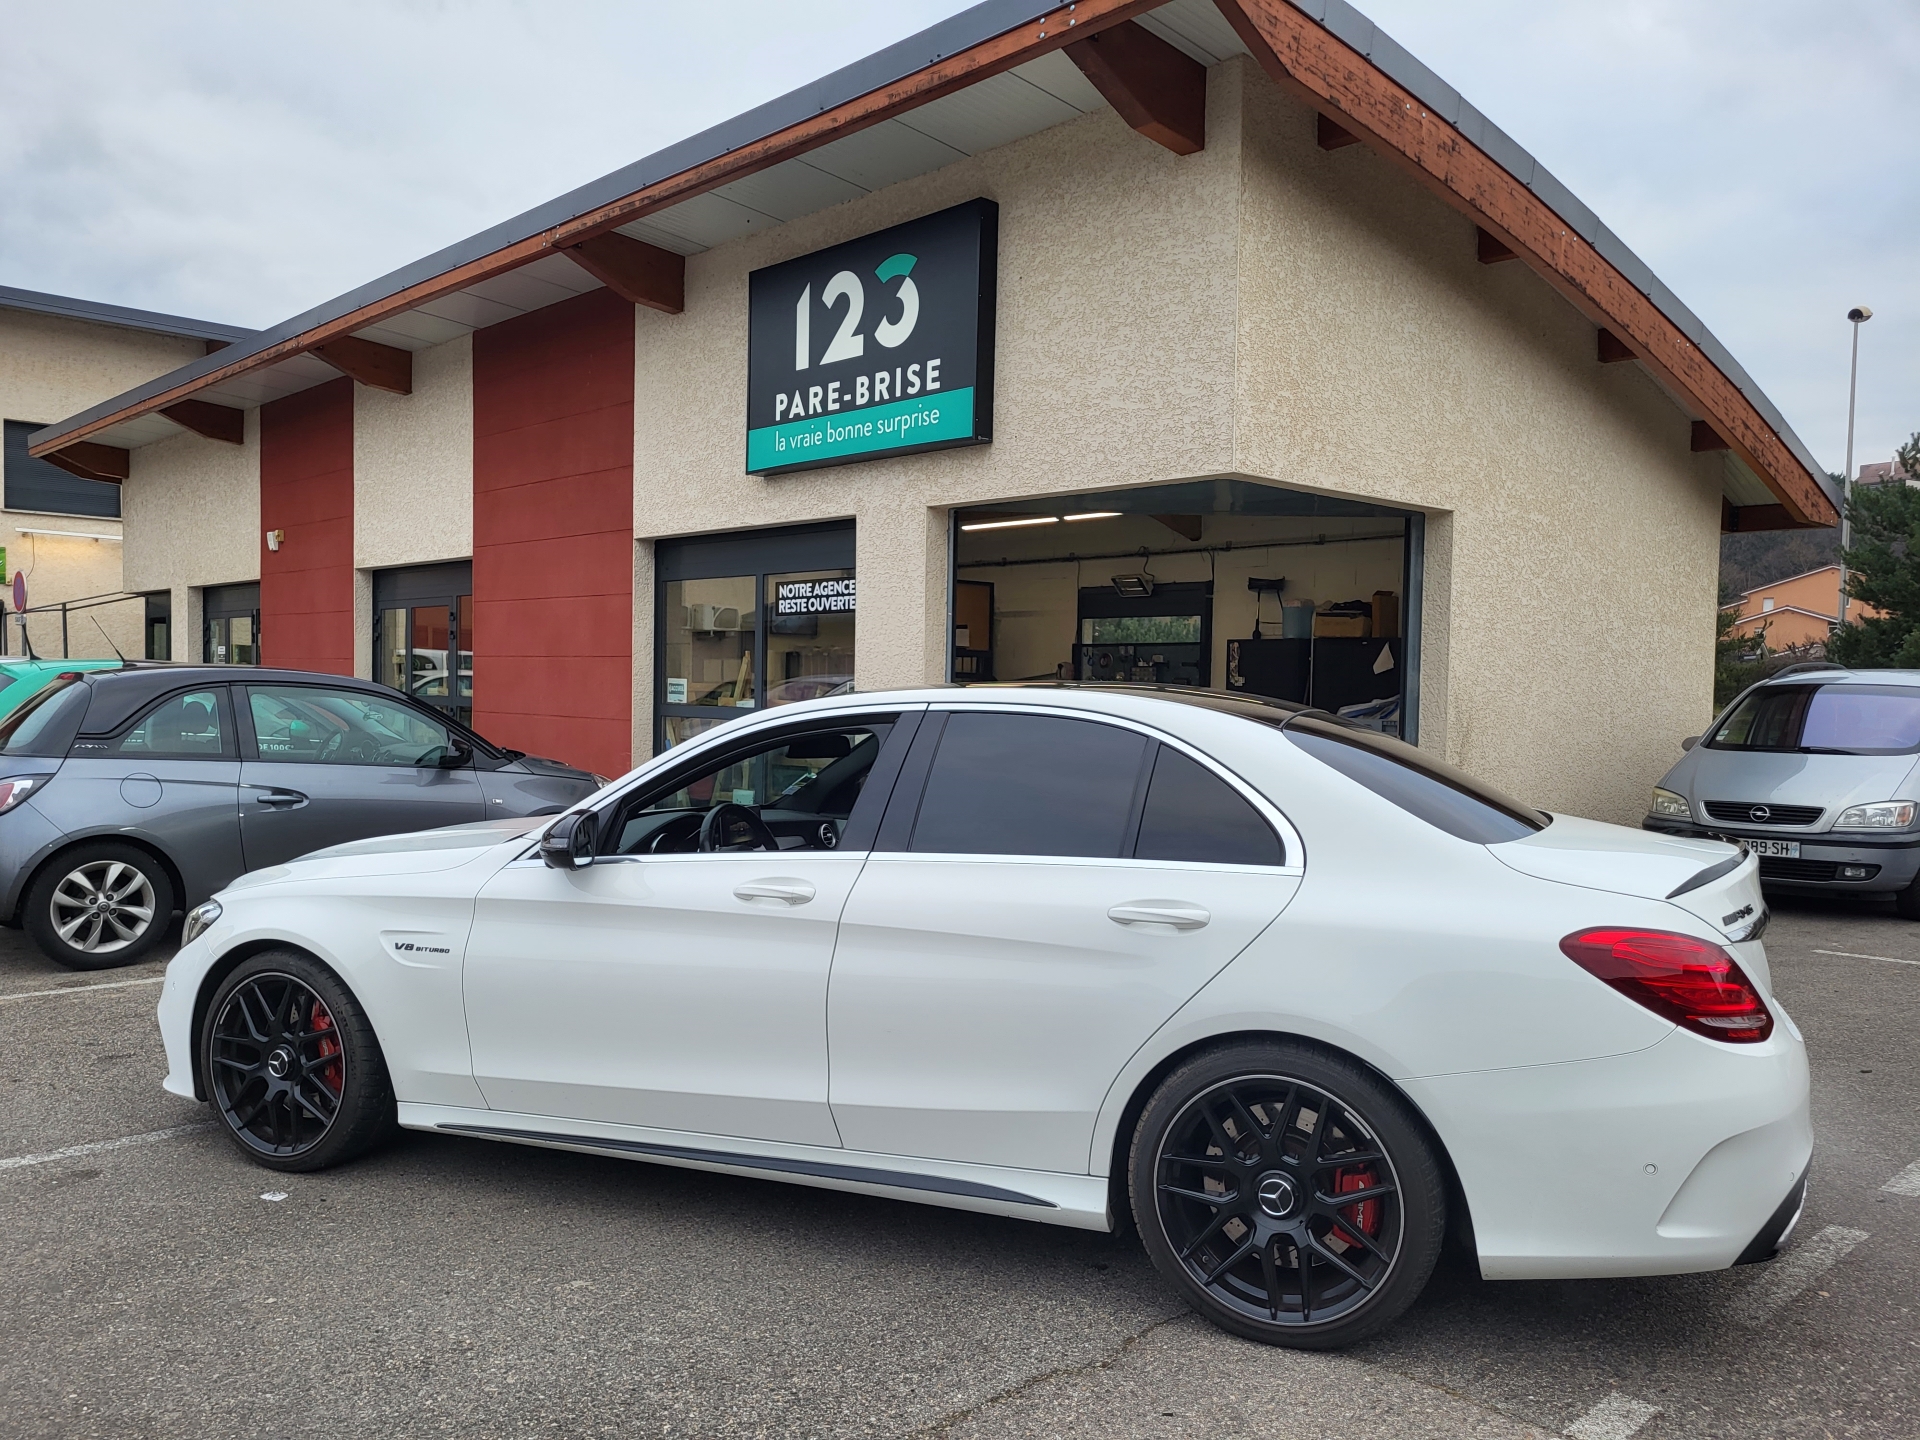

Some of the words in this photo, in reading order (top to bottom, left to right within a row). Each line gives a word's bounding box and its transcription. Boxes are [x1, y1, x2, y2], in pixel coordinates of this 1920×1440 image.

[796, 253, 920, 371] 123
[775, 358, 941, 422] PARE-BRISE
[775, 430, 786, 451] la
[789, 424, 823, 449] vraie
[826, 420, 873, 443] bonne
[876, 403, 940, 439] surprise
[778, 598, 808, 613] RESTE
[808, 595, 856, 612] OUVERTE
[779, 583, 813, 598] NOTRE
[813, 580, 856, 596] AGENCE
[394, 942, 415, 951] V8
[415, 946, 451, 954] BITURBO
